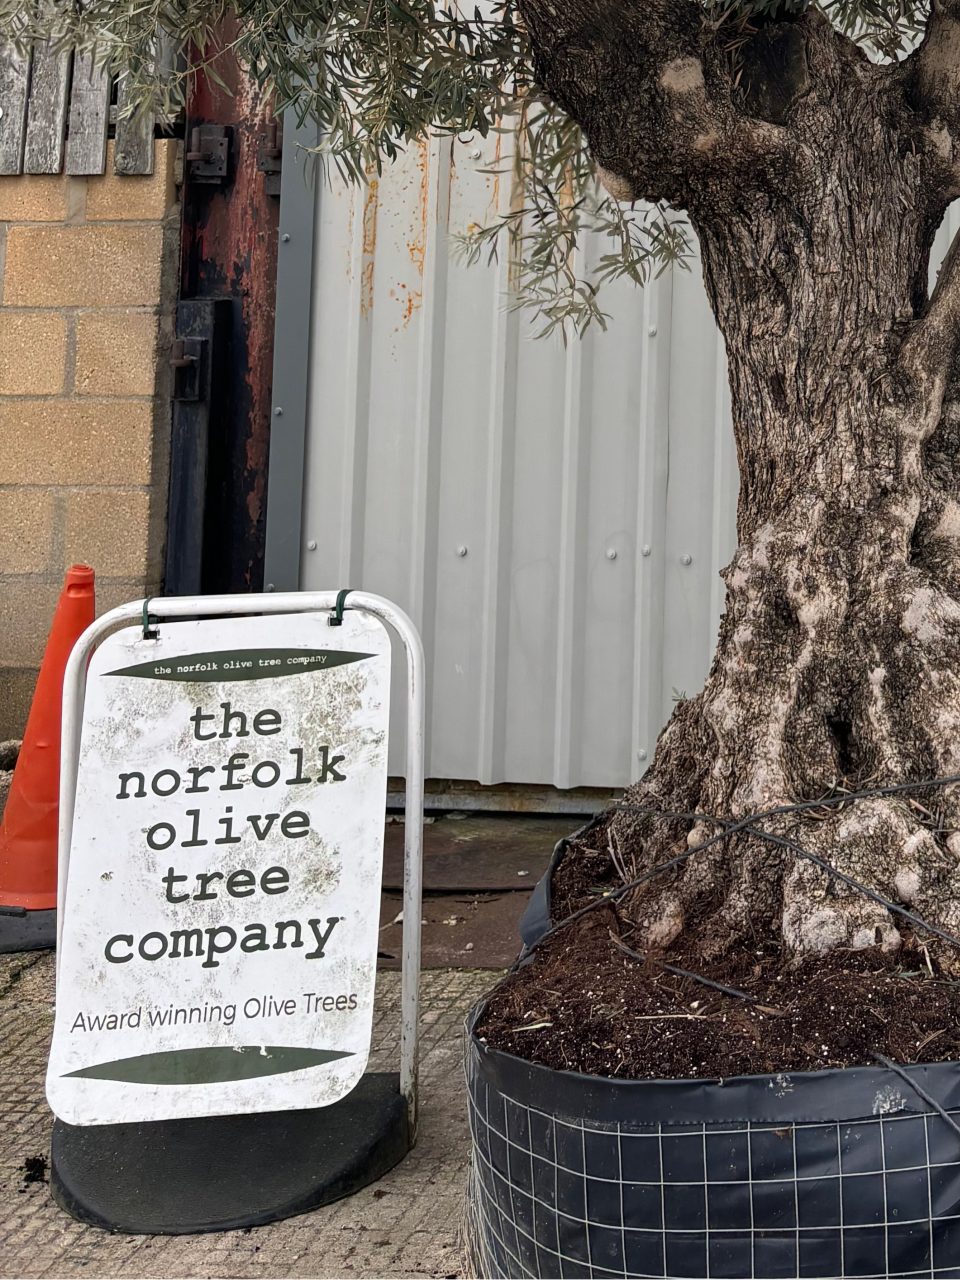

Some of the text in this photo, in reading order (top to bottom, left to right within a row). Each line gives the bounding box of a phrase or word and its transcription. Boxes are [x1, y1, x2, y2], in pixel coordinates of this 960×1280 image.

[154, 654, 328, 675] the norfolk olive tree company
[190, 702, 282, 741] the
[116, 746, 347, 799] norfolk
[146, 806, 310, 851] olive
[162, 866, 290, 904] tree
[104, 916, 340, 969] company
[70, 992, 358, 1034] Award winning Olive Trees
